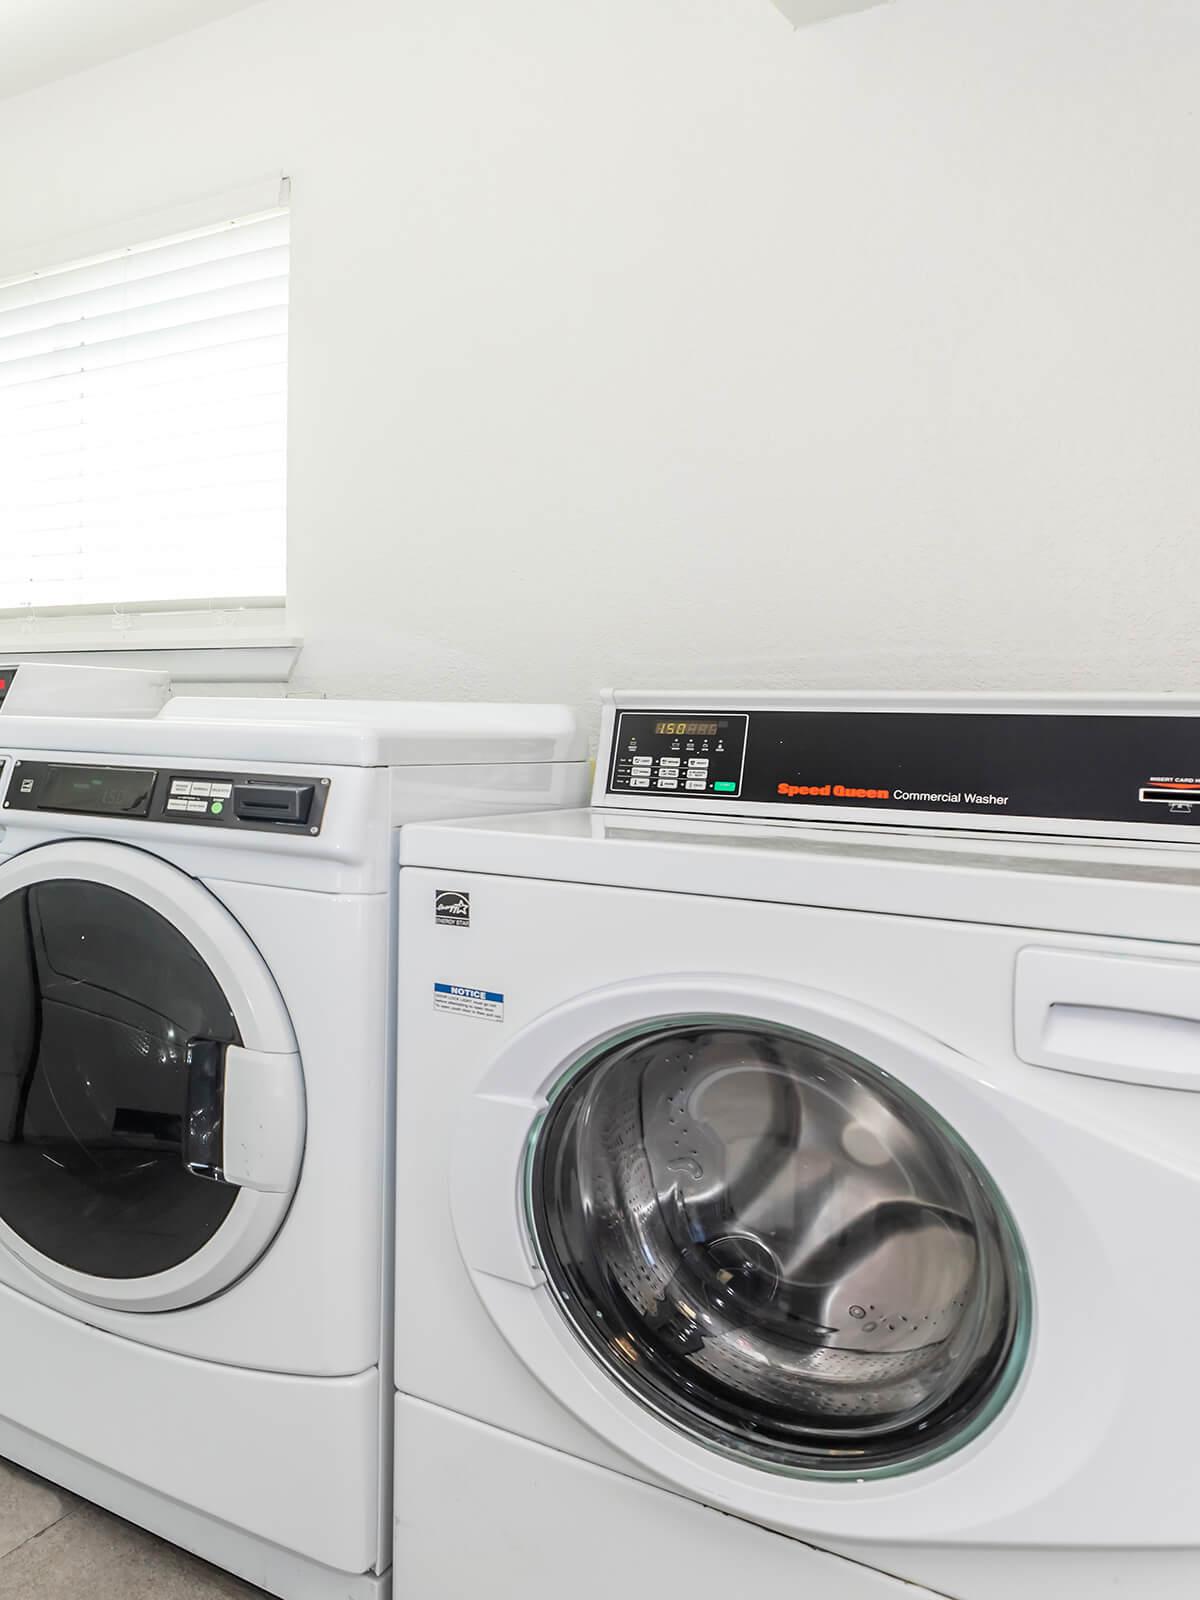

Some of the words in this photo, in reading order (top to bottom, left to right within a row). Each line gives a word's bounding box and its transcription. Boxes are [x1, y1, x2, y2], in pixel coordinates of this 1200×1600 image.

[777, 783, 831, 797] Speed
[832, 785, 890, 800] Queen
[893, 789, 961, 804] Commercial
[964, 793, 1009, 805] Washer
[450, 986, 487, 1001] NOTICE
